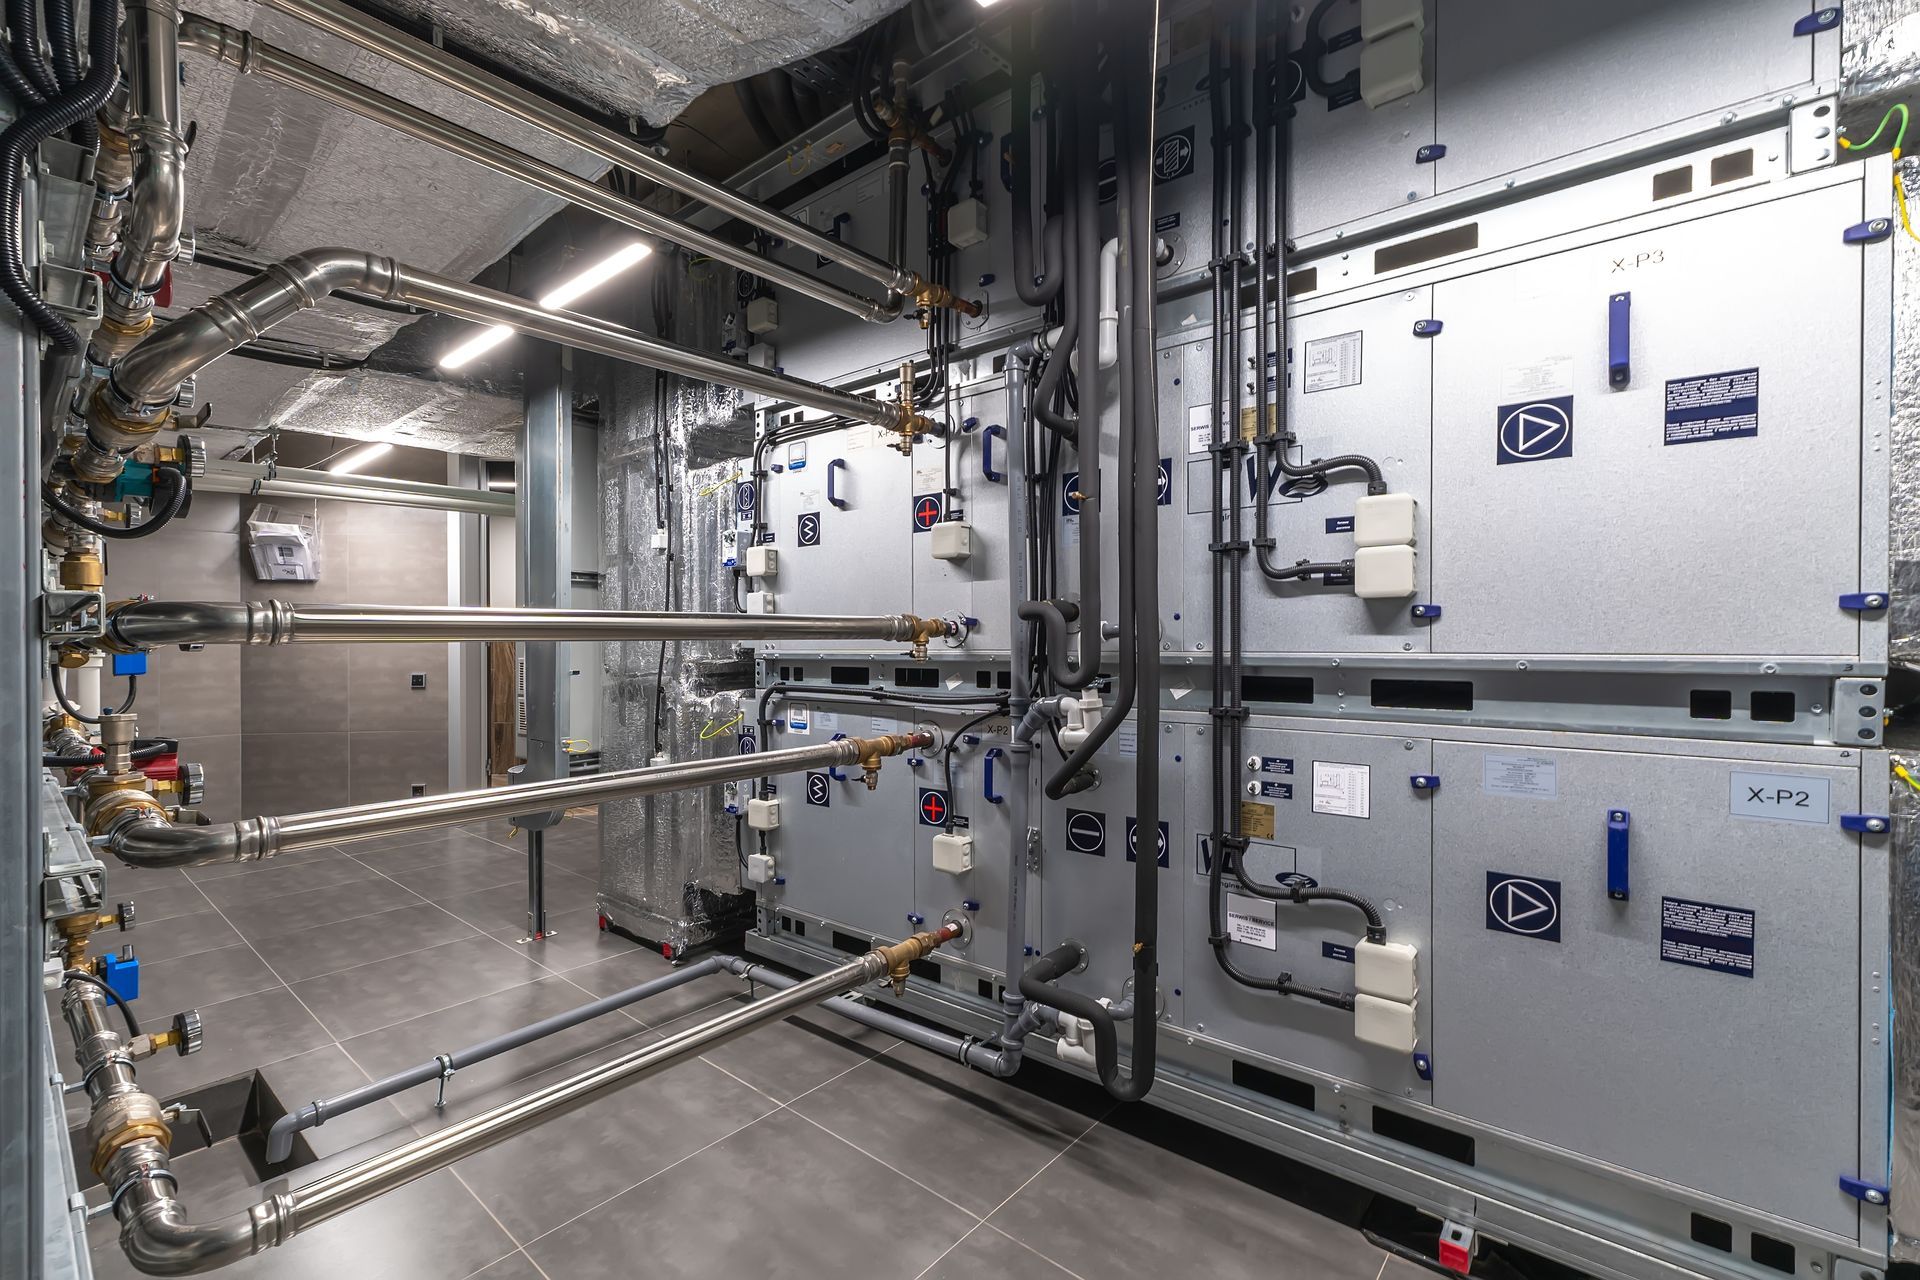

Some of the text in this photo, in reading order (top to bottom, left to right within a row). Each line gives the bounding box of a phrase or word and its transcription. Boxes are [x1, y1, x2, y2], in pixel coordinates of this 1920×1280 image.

[1611, 248, 1665, 274] X-P3
[987, 724, 1009, 736] X-P2
[1746, 786, 1810, 808] X-P2
